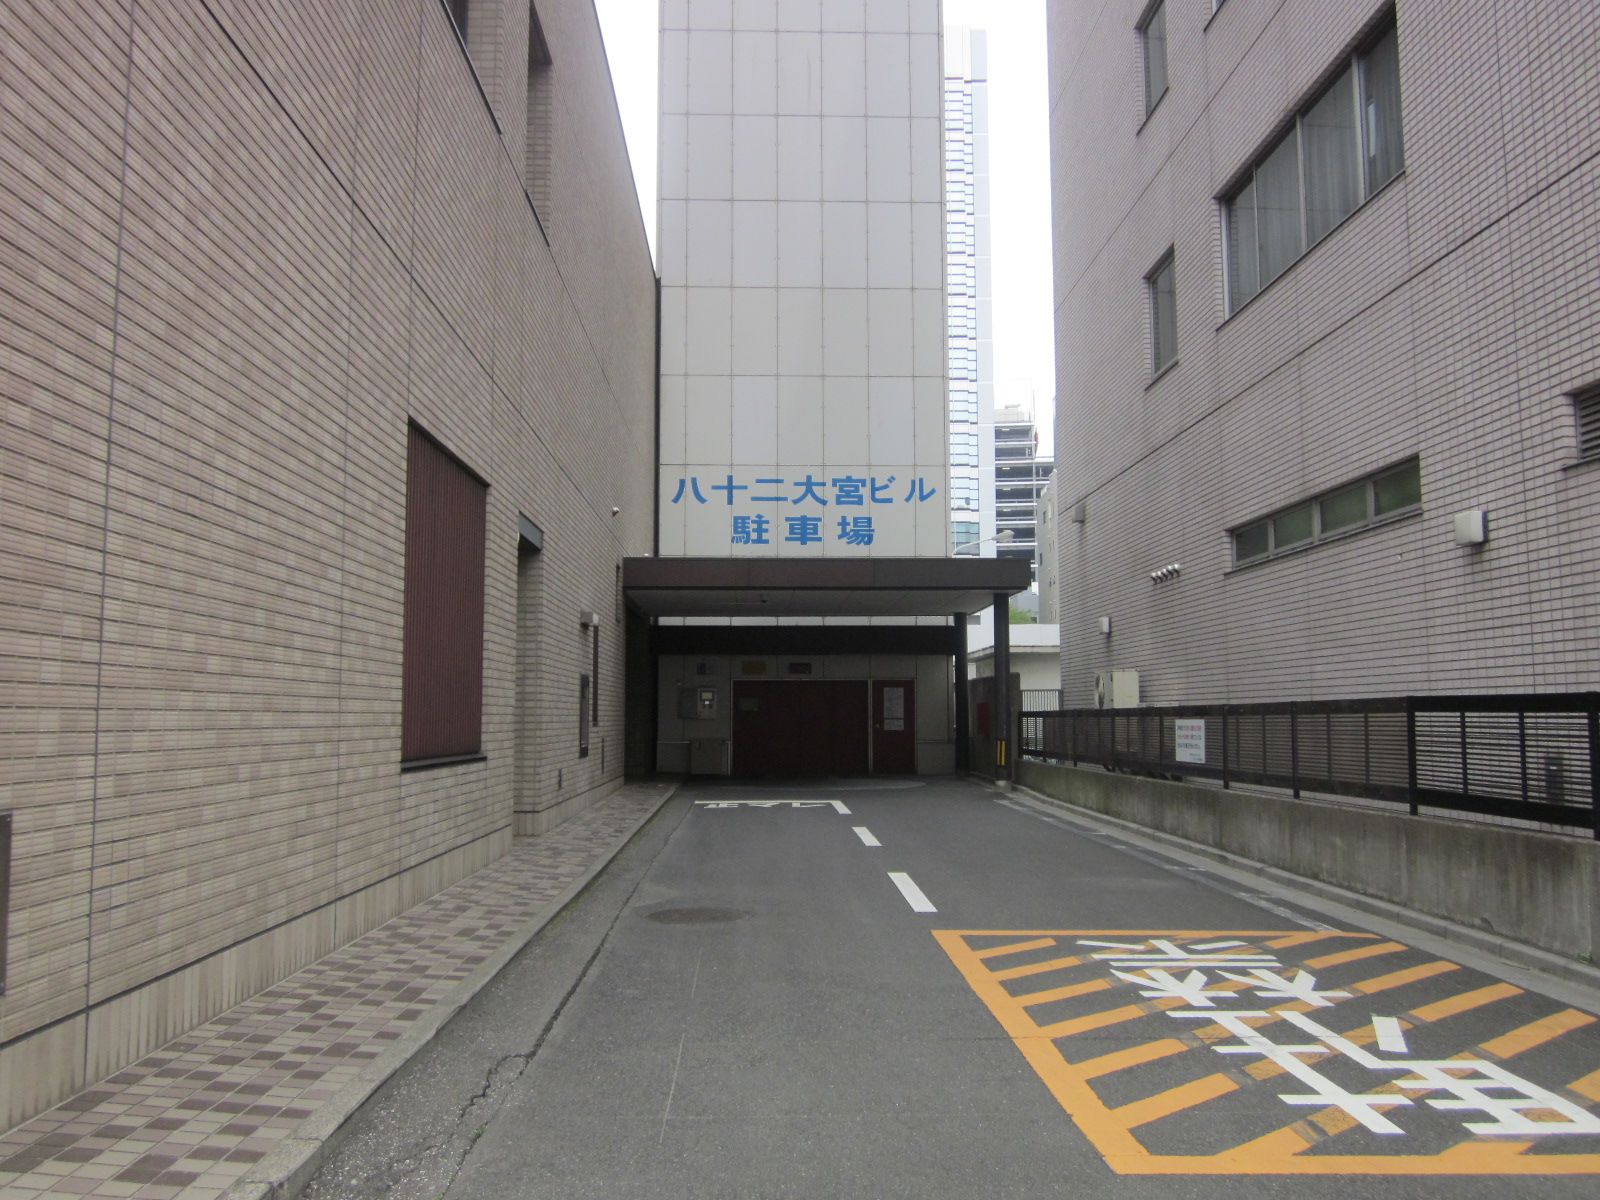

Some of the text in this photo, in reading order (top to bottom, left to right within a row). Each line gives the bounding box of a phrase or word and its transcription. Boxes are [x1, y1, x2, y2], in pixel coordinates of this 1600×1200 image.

[671, 474, 937, 506] 八十二大宮ビル
[730, 514, 875, 545] 駐車場
